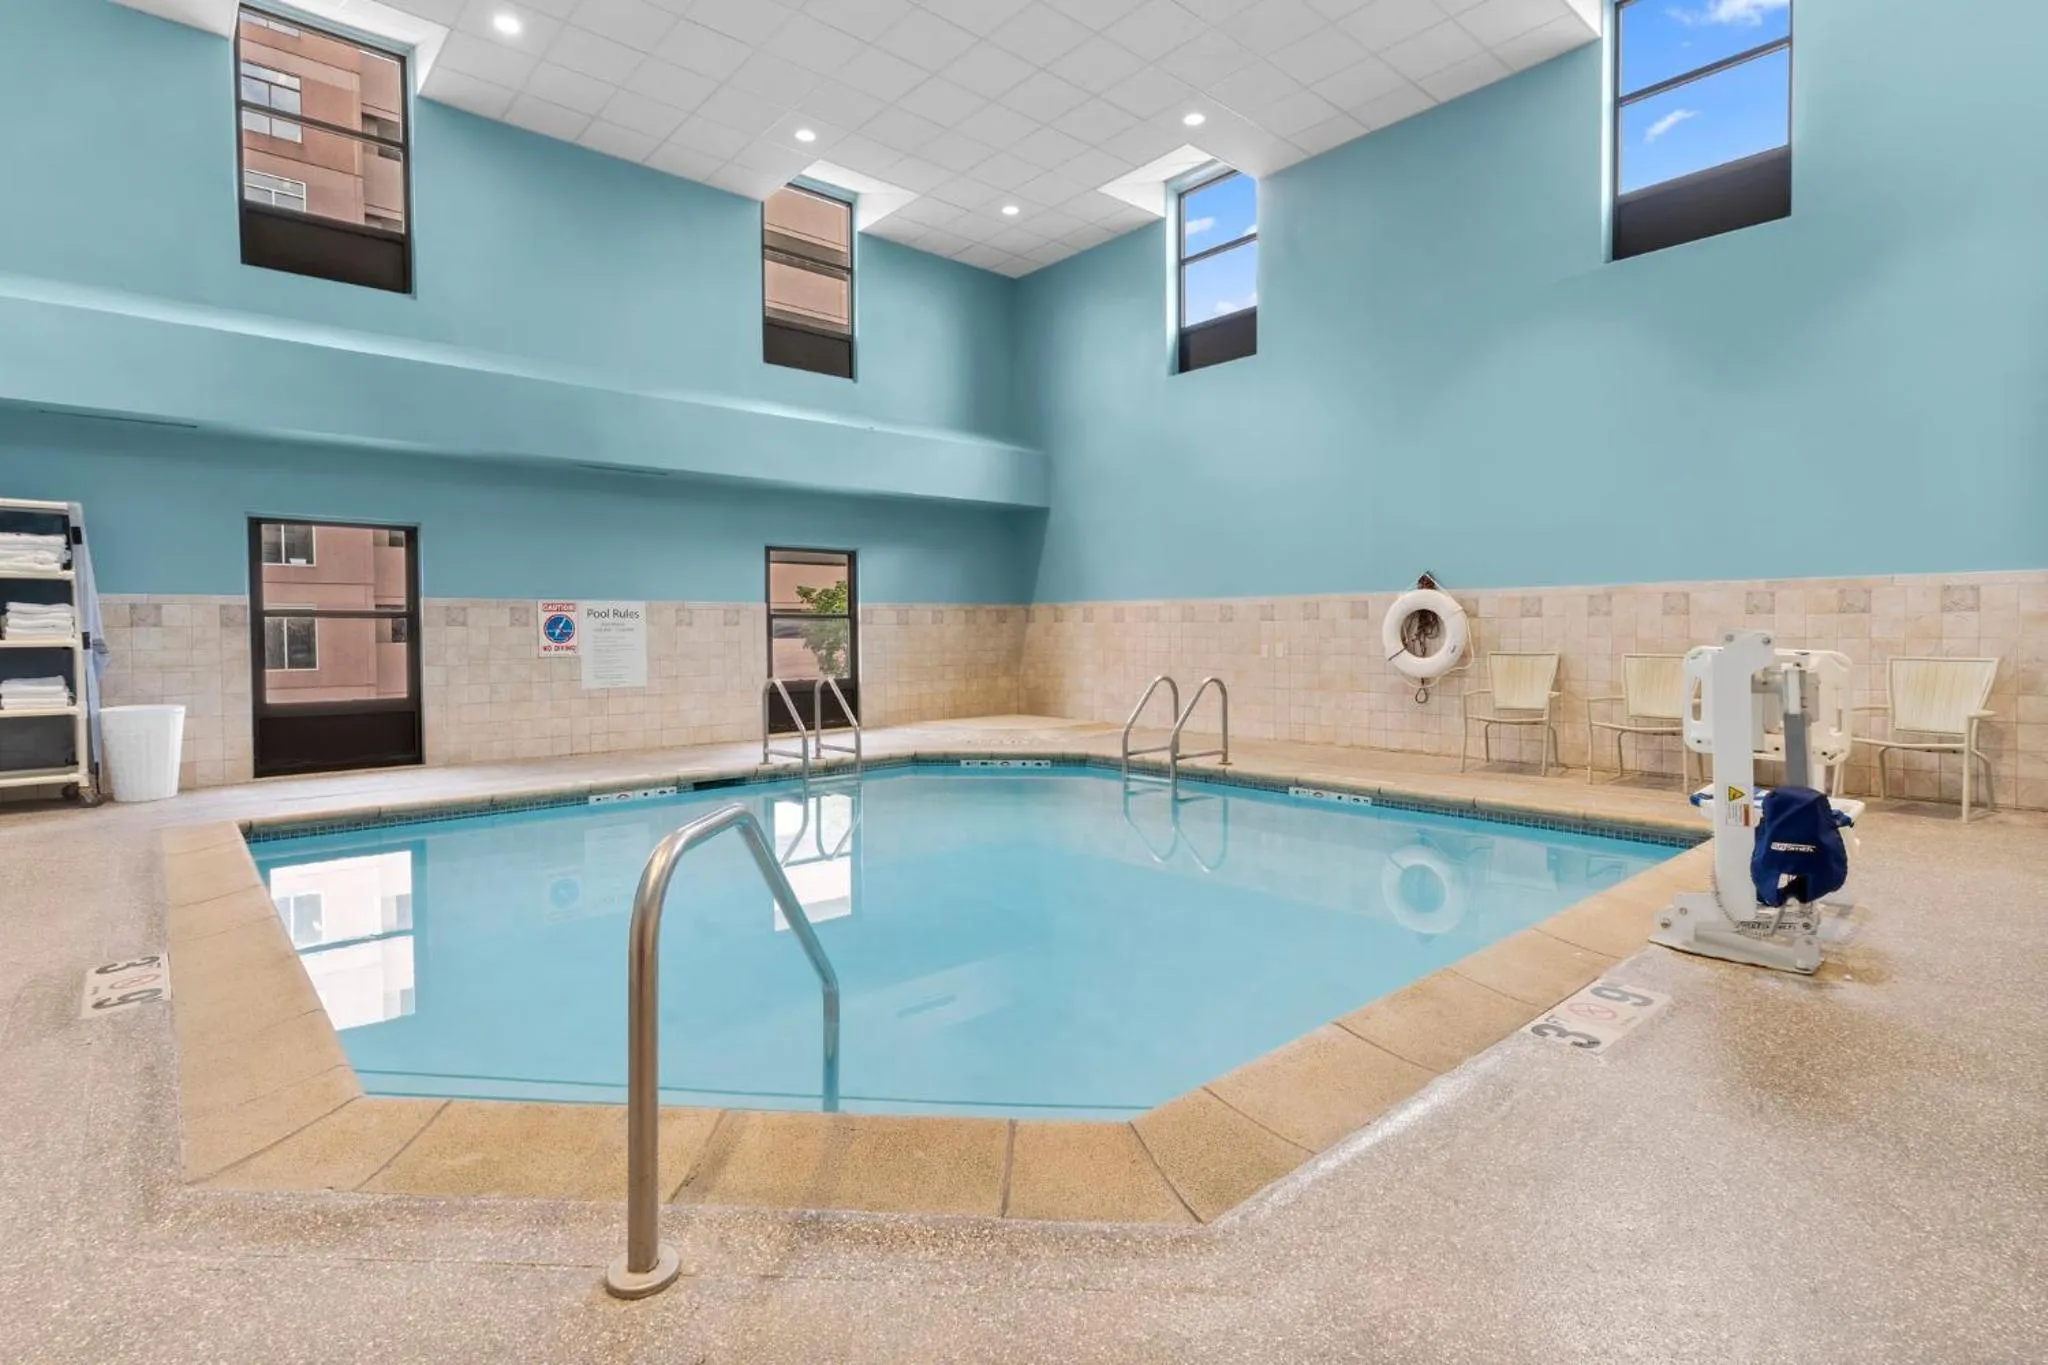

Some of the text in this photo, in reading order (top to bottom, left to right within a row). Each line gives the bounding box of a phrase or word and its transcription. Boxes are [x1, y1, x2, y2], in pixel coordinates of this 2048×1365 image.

[586, 608, 640, 619] Pool Rules
[1531, 1023, 1601, 1048] 3
